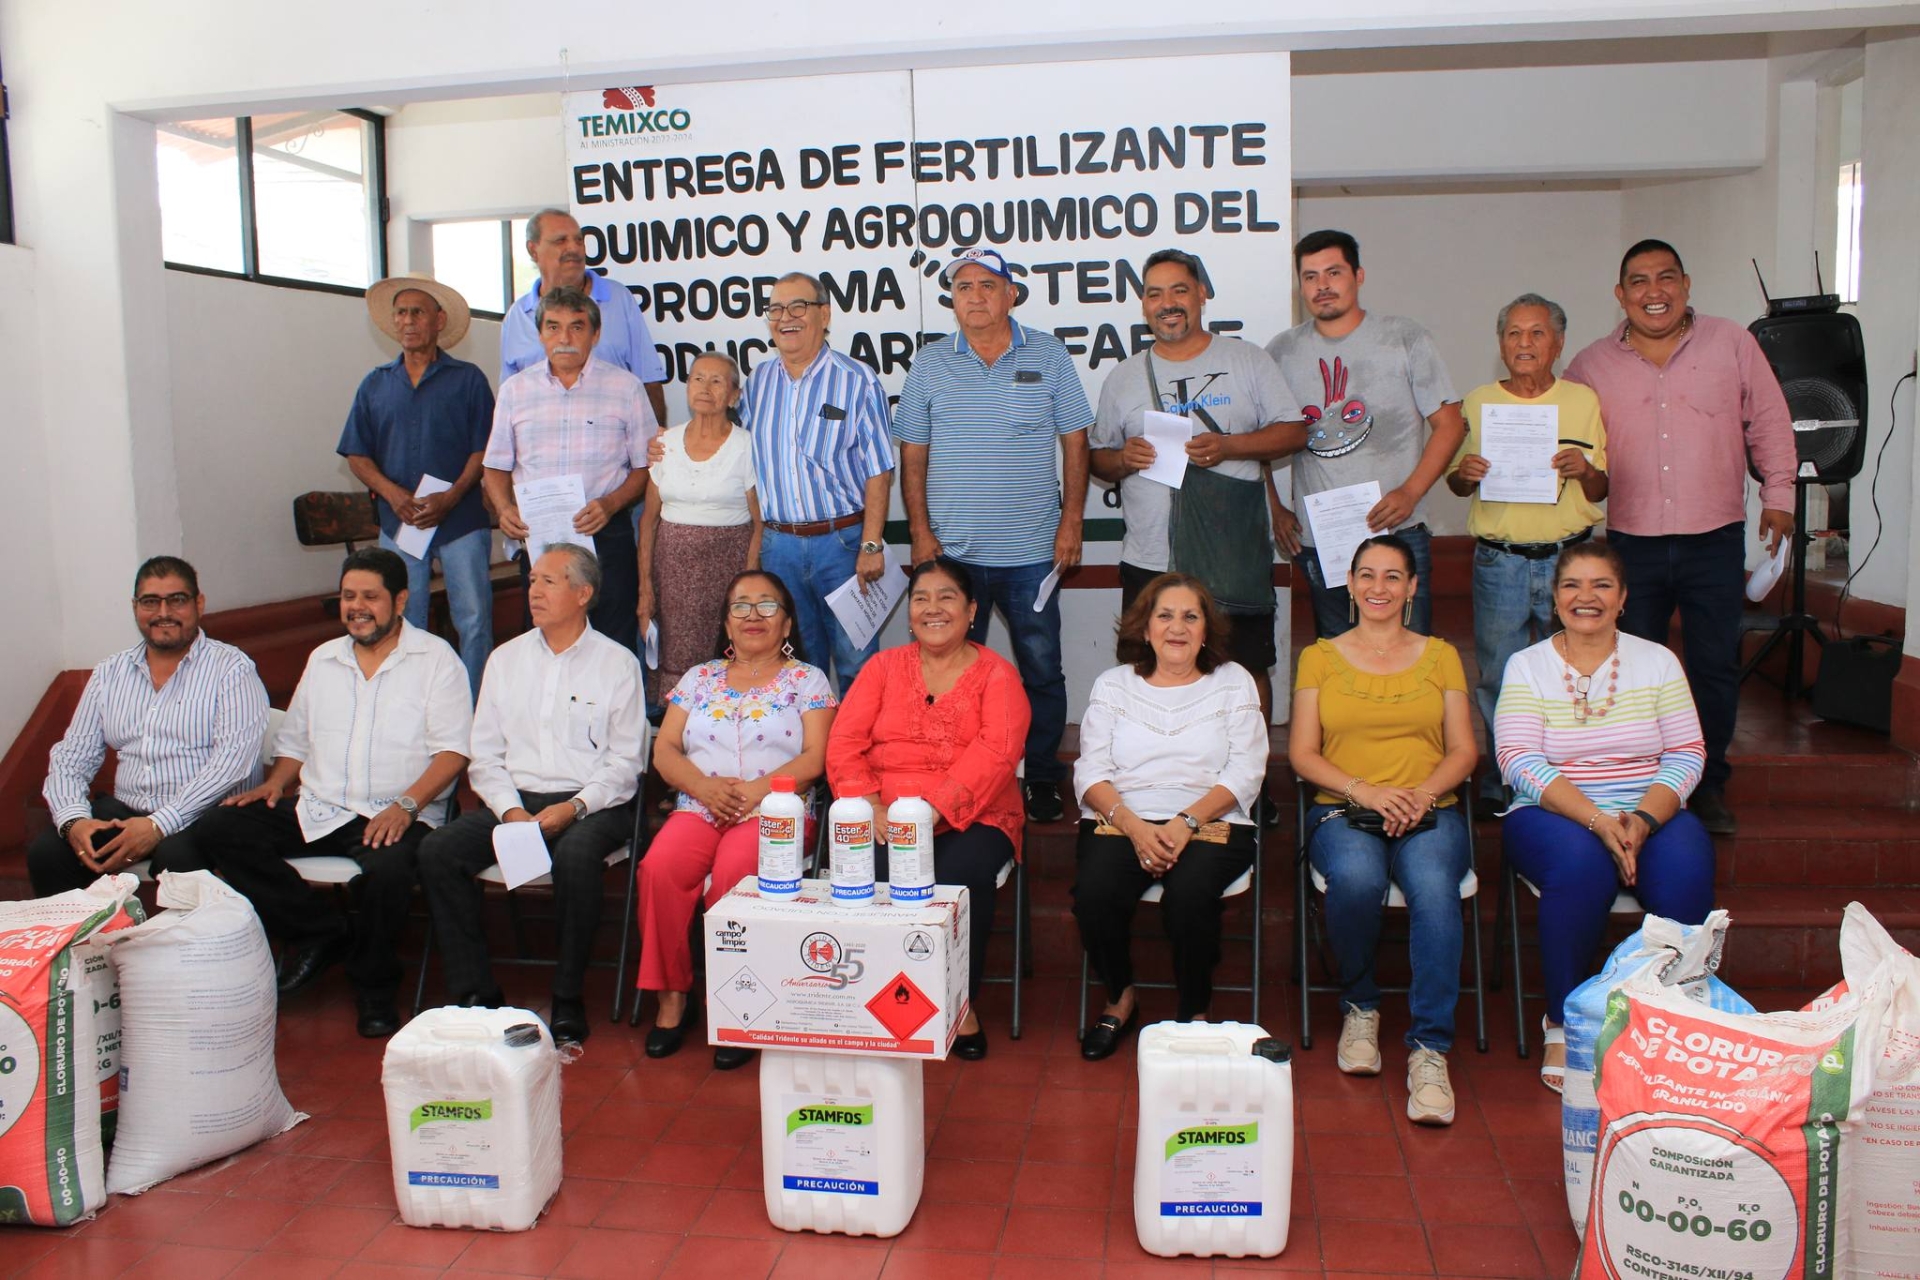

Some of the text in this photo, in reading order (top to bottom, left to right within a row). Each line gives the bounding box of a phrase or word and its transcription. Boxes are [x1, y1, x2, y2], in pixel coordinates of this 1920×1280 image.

[578, 108, 691, 137] TEMIXCO
[573, 122, 1267, 205] ENTREGA DE FERTILIZANTE
[776, 209, 811, 253] Y
[822, 192, 1158, 257] AGROQUIMICO
[1174, 188, 1281, 235] DEL
[1201, 392, 1231, 407] Klein
[834, 824, 861, 835] Ester
[836, 834, 850, 843] 40
[835, 886, 874, 897] PRECAUCIÓN
[715, 930, 742, 939] campo
[721, 936, 746, 947] limpio
[780, 978, 831, 989] Aniversario
[743, 1012, 749, 1021] 6
[56, 1016, 67, 1035] DE
[775, 1035, 800, 1043] Tridente
[809, 1037, 827, 1045] aliado
[844, 1039, 864, 1047] campo
[1630, 1028, 1663, 1059] DE
[56, 1036, 67, 1096] CLORURO
[1616, 1050, 1707, 1096] FERTILIZANTE
[1652, 1088, 1747, 1114] GRANULADO
[421, 1104, 482, 1120] STAMFOS
[798, 1108, 863, 1125] STAMFOS
[1177, 1131, 1246, 1145] STAMFOS
[1879, 1138, 1902, 1146] CASO
[1652, 1147, 1734, 1169] COMPOSICIÓN
[56, 1147, 74, 1207] 00-00-60
[1650, 1158, 1735, 1182] GARANTIZADA
[421, 1174, 487, 1186] PRECAUCIÓN
[797, 1179, 866, 1192] PRECAUCIÓN
[1632, 1180, 1640, 1191] N
[1818, 1175, 1829, 1197] DE
[1175, 1203, 1248, 1214] PRECAUCIÓN
[1618, 1190, 1772, 1242] 00-00-60
[1815, 1199, 1828, 1274] CLORURO
[1625, 1243, 1754, 1280] RSCO-3145/XII/94
